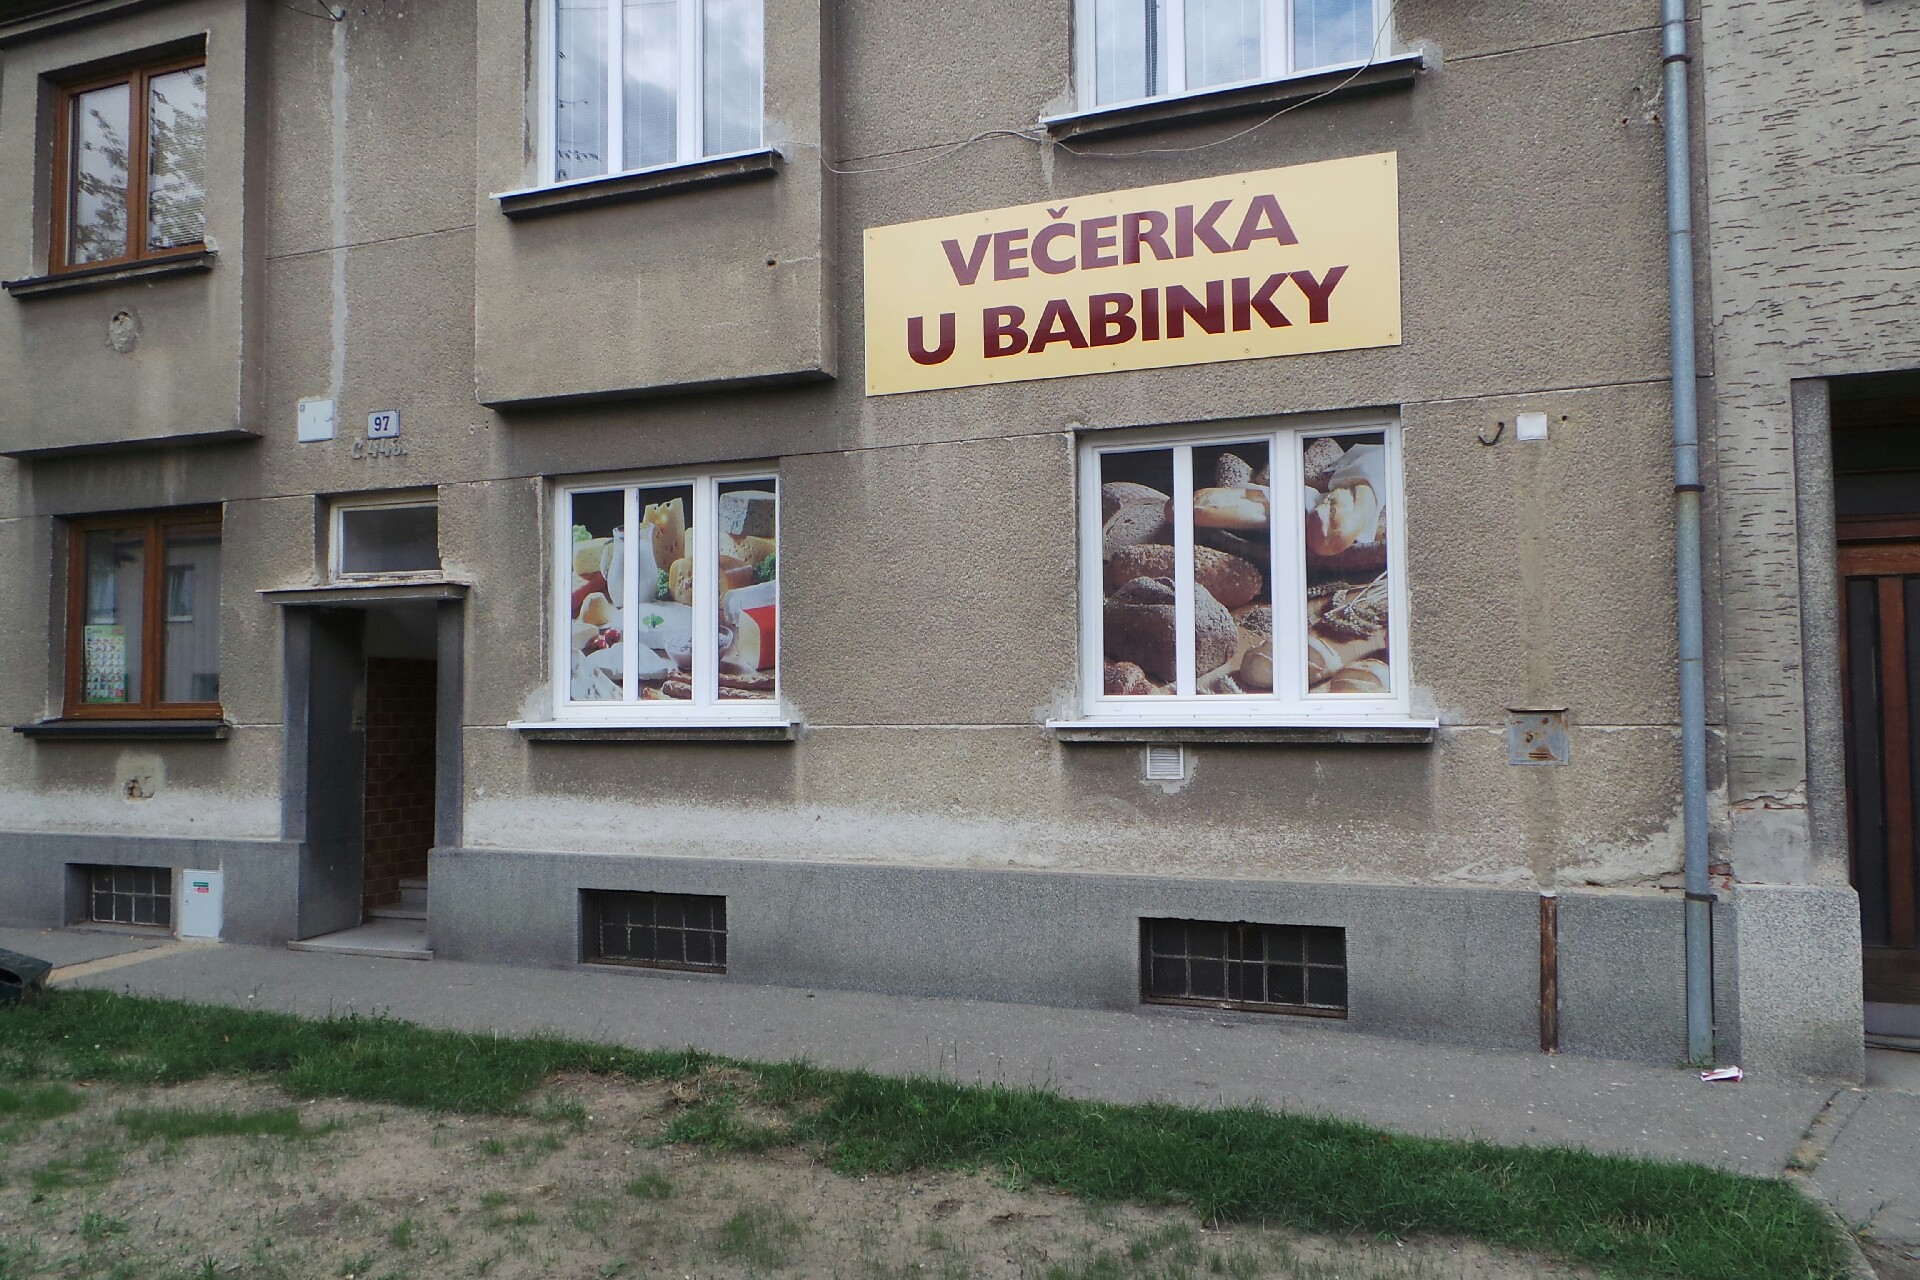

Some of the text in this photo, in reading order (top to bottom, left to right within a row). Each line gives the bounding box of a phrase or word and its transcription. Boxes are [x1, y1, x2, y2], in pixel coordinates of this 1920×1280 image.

[941, 194, 1299, 286] VEČERKA
[907, 265, 1350, 366] U BABINKY
[374, 416, 390, 431] 97
